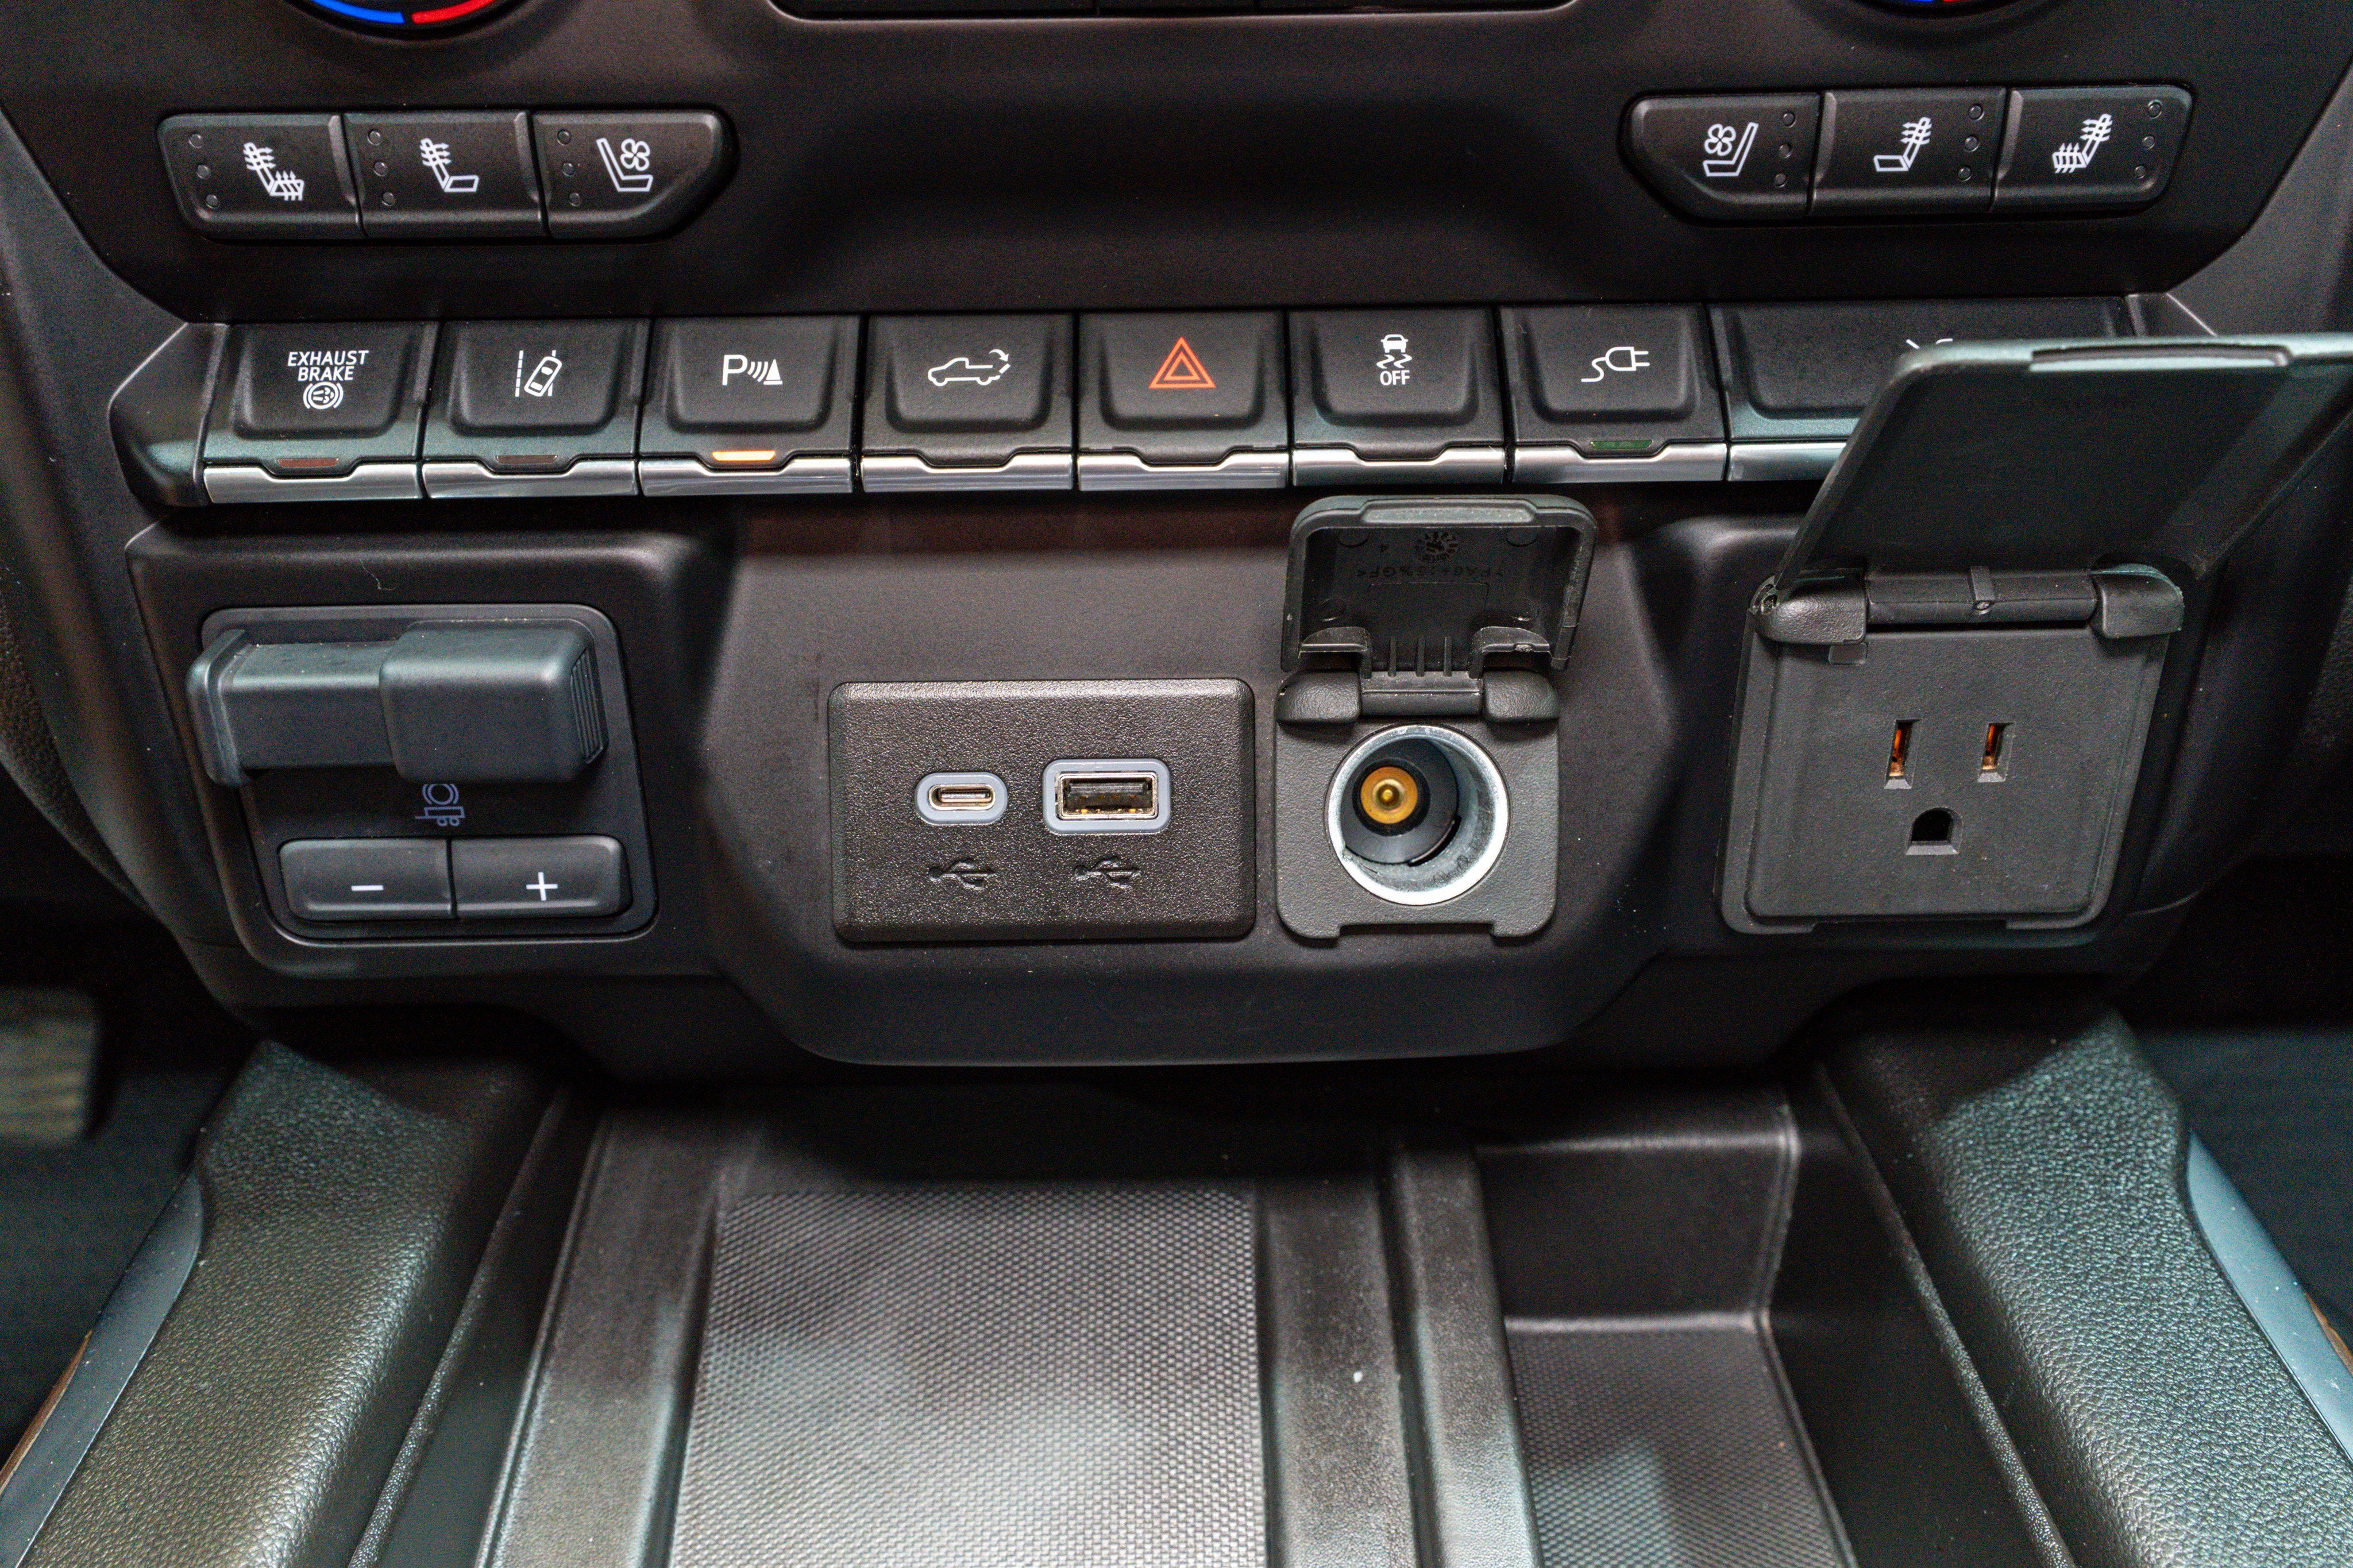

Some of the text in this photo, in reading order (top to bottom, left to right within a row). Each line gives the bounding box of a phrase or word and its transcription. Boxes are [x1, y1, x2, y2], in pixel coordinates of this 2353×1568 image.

[287, 350, 369, 367] EXHAUST
[298, 365, 355, 381] BRAKE
[722, 354, 749, 386] P
[1379, 369, 1410, 387] OFF
